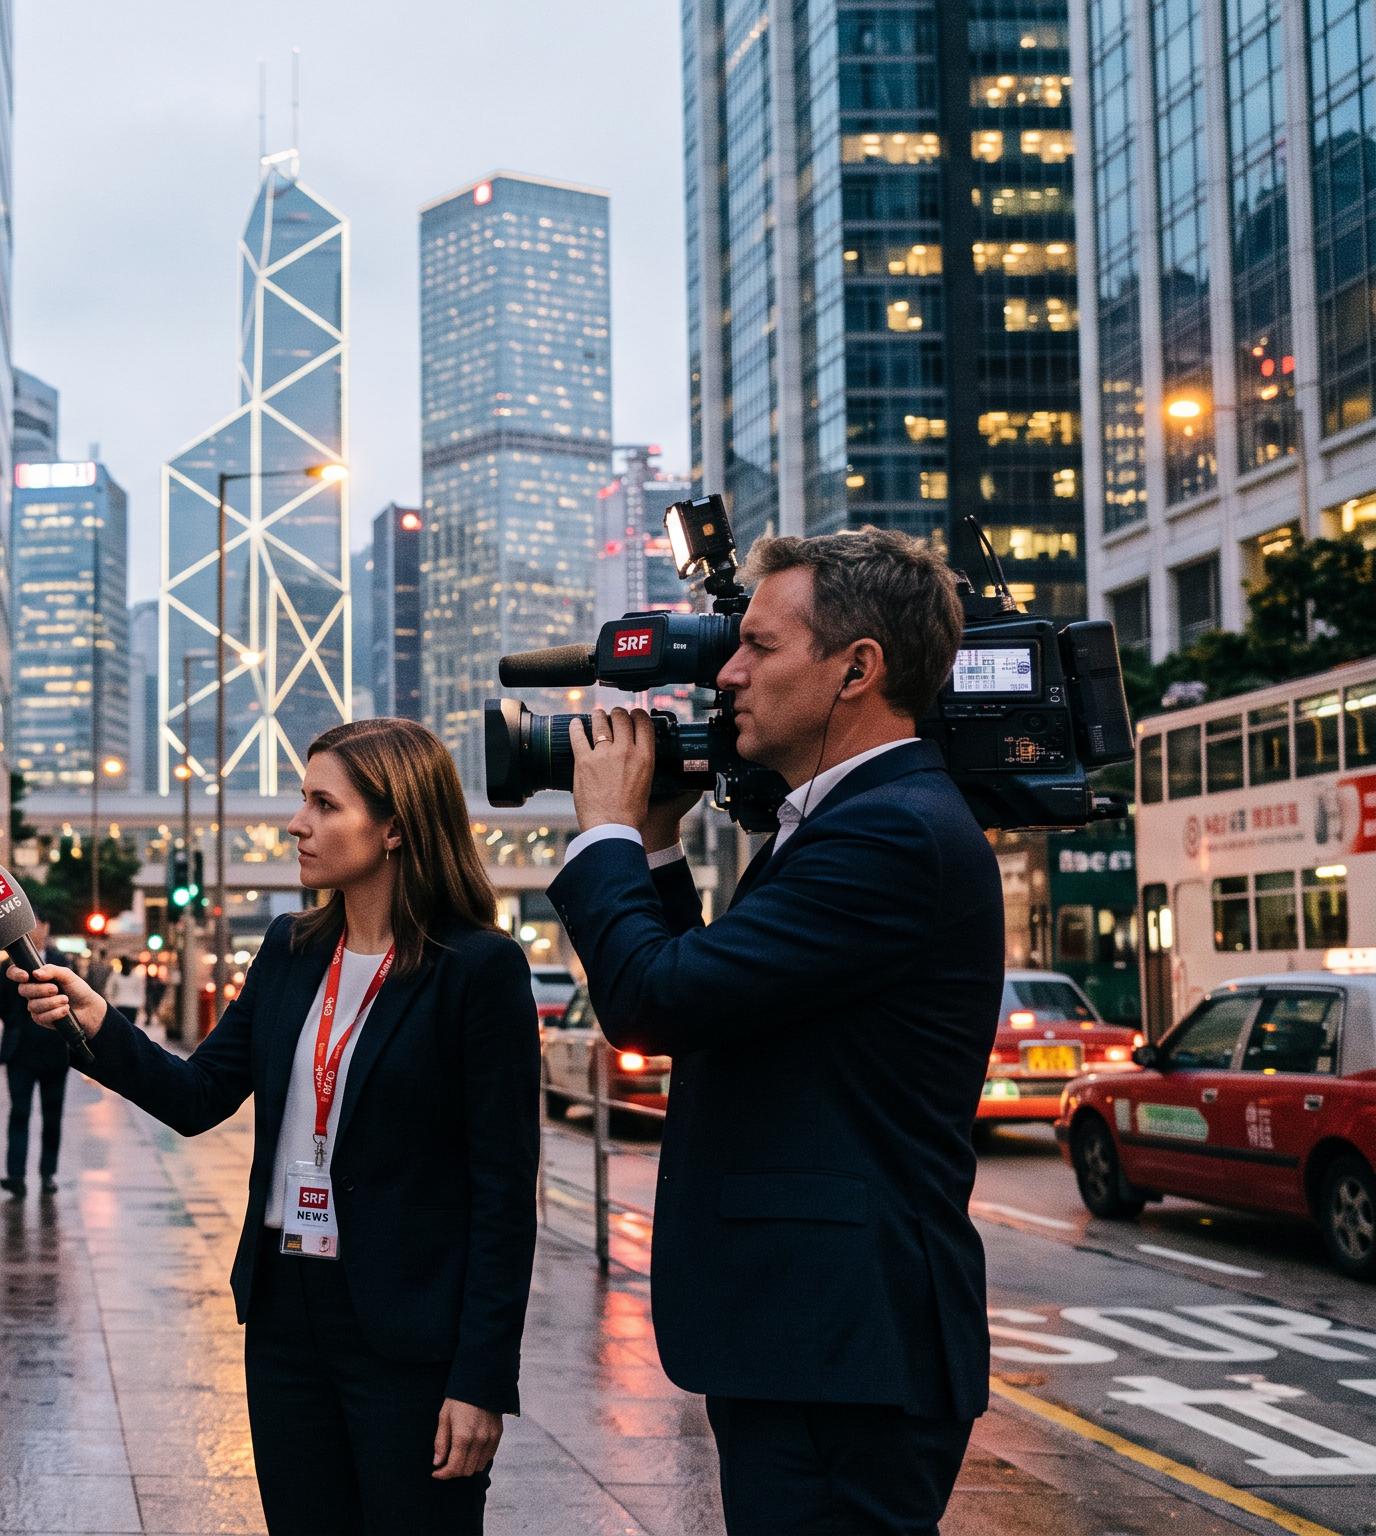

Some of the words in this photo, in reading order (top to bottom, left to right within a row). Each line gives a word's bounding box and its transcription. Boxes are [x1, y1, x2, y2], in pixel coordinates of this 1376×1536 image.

[617, 635, 649, 652] SRF
[302, 1192, 326, 1205] SRF
[297, 1211, 329, 1222] NEWS
